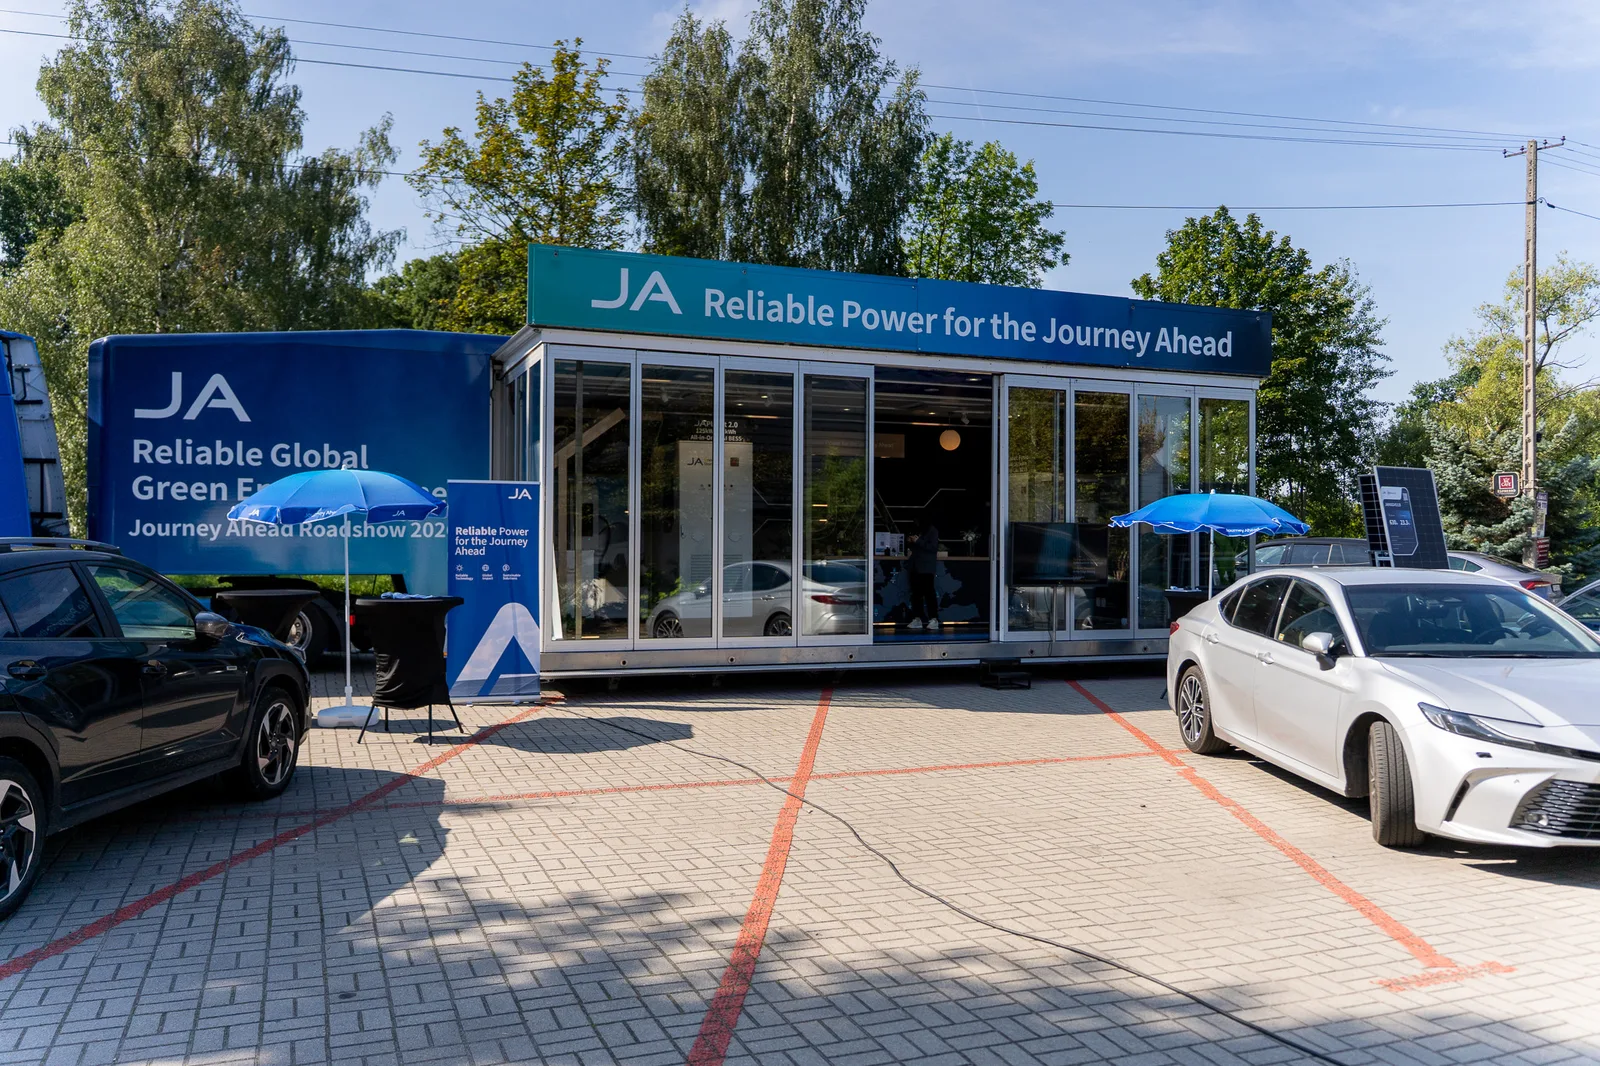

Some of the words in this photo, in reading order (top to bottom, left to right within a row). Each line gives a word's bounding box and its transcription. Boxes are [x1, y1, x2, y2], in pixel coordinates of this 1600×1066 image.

[591, 268, 683, 315] JA
[704, 288, 835, 327] Reliable
[841, 299, 937, 335] Power
[942, 306, 986, 338] for
[990, 311, 1036, 342] the
[1042, 317, 1151, 358] Journey
[1154, 326, 1233, 358] Ahead
[134, 371, 252, 422] JA
[133, 438, 264, 467] Reliable
[270, 442, 369, 470] Global
[131, 475, 228, 501] Green
[508, 488, 532, 500] JA
[128, 519, 222, 541] Journey
[225, 518, 294, 538] Ahead
[299, 520, 407, 538] Roadshow
[410, 521, 449, 538] 202
[455, 526, 497, 536] Reliable
[499, 528, 529, 536] Power
[455, 536, 470, 546] for
[471, 536, 487, 546] the
[489, 537, 528, 548] Journey
[455, 546, 486, 556] Ahead
